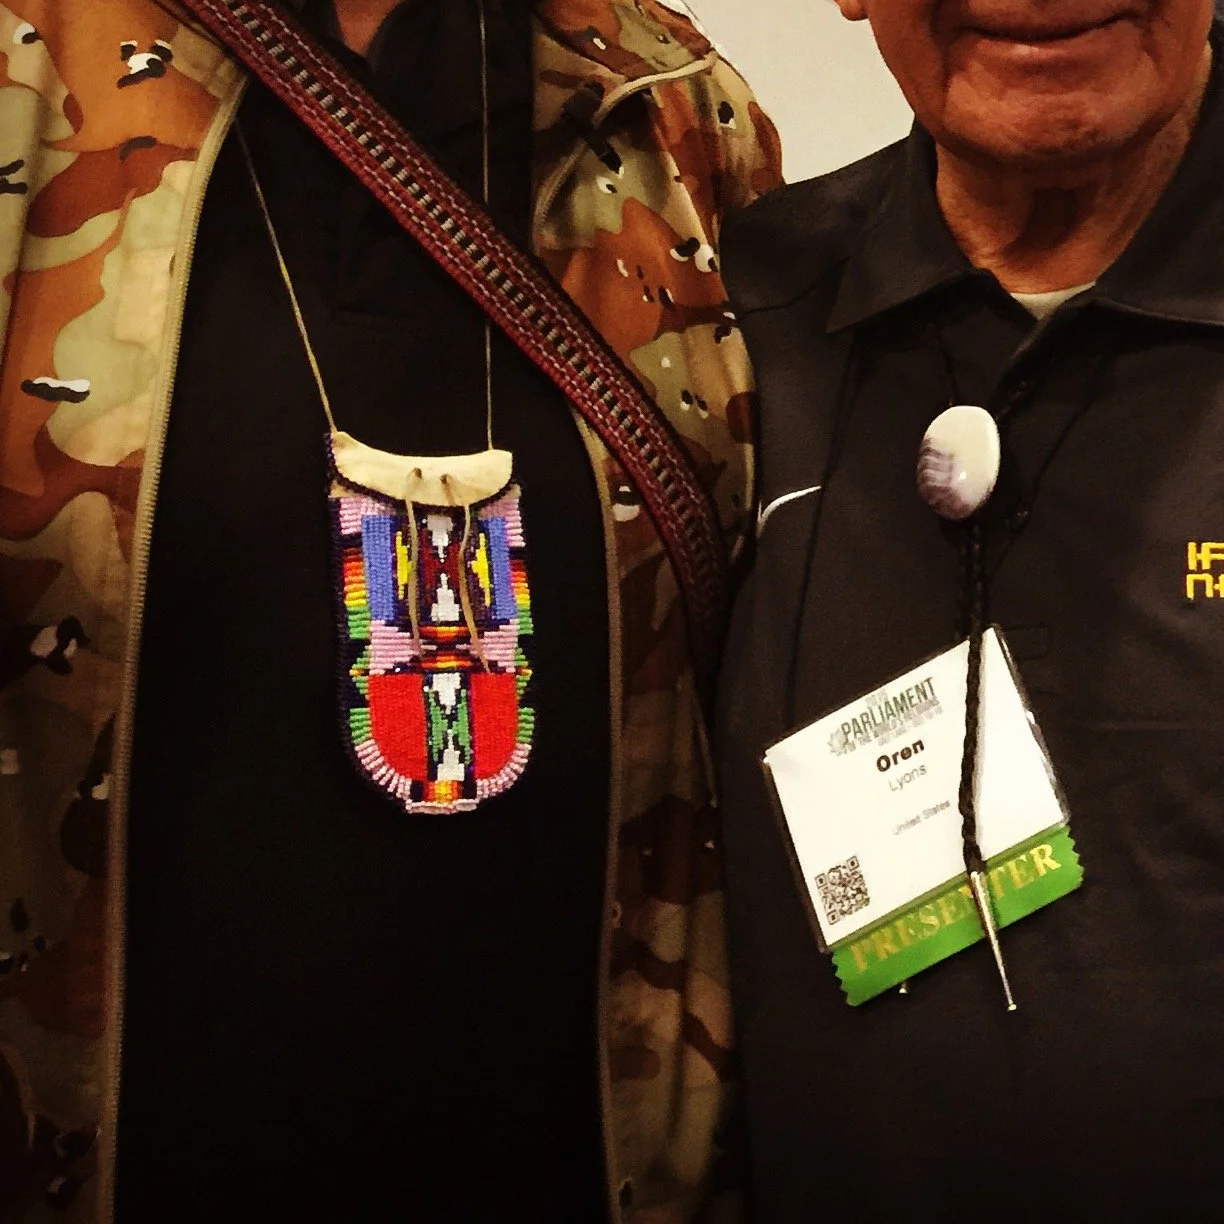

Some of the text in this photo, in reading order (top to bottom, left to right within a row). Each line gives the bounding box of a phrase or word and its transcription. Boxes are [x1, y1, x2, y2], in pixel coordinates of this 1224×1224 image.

[840, 676, 937, 746] PARLIAMENT
[876, 739, 925, 773] Oren
[888, 764, 928, 792] Lyons
